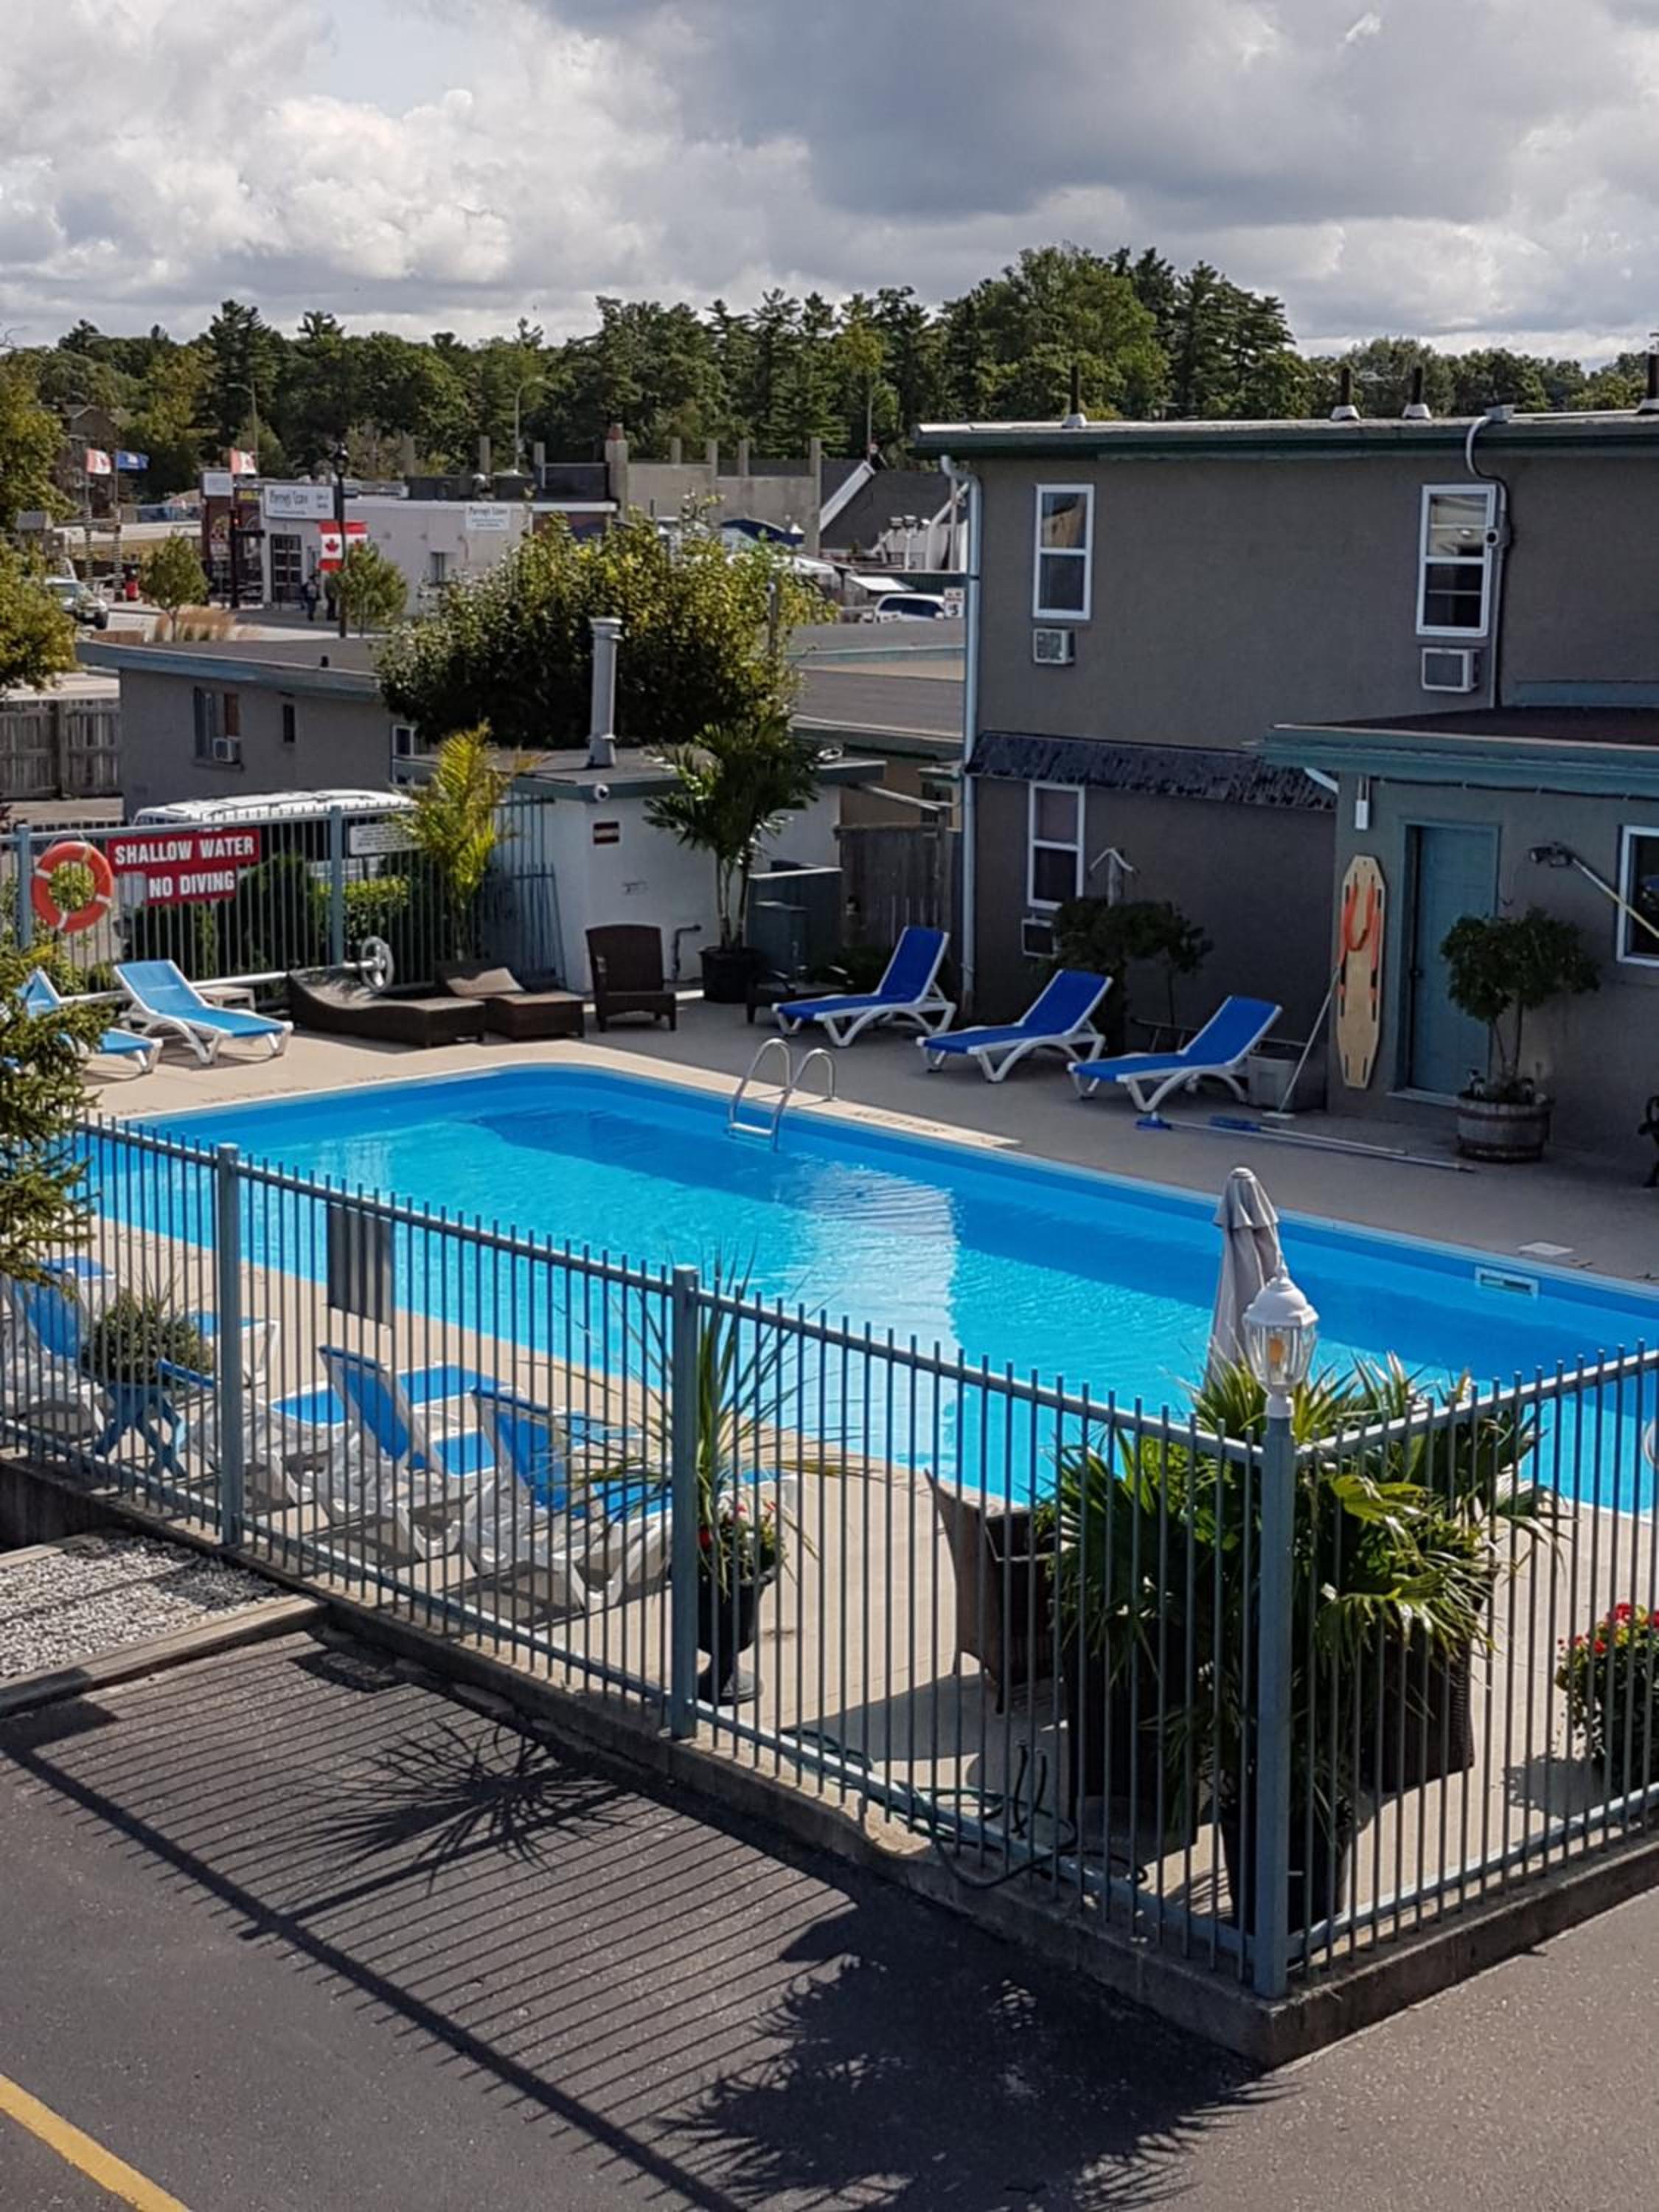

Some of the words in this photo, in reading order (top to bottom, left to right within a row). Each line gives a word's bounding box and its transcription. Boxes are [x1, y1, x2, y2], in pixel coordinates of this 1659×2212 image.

[114, 841, 192, 865] SHALLOW
[200, 836, 254, 859] WATER
[149, 877, 173, 898] NO
[180, 871, 234, 895] DIVING
